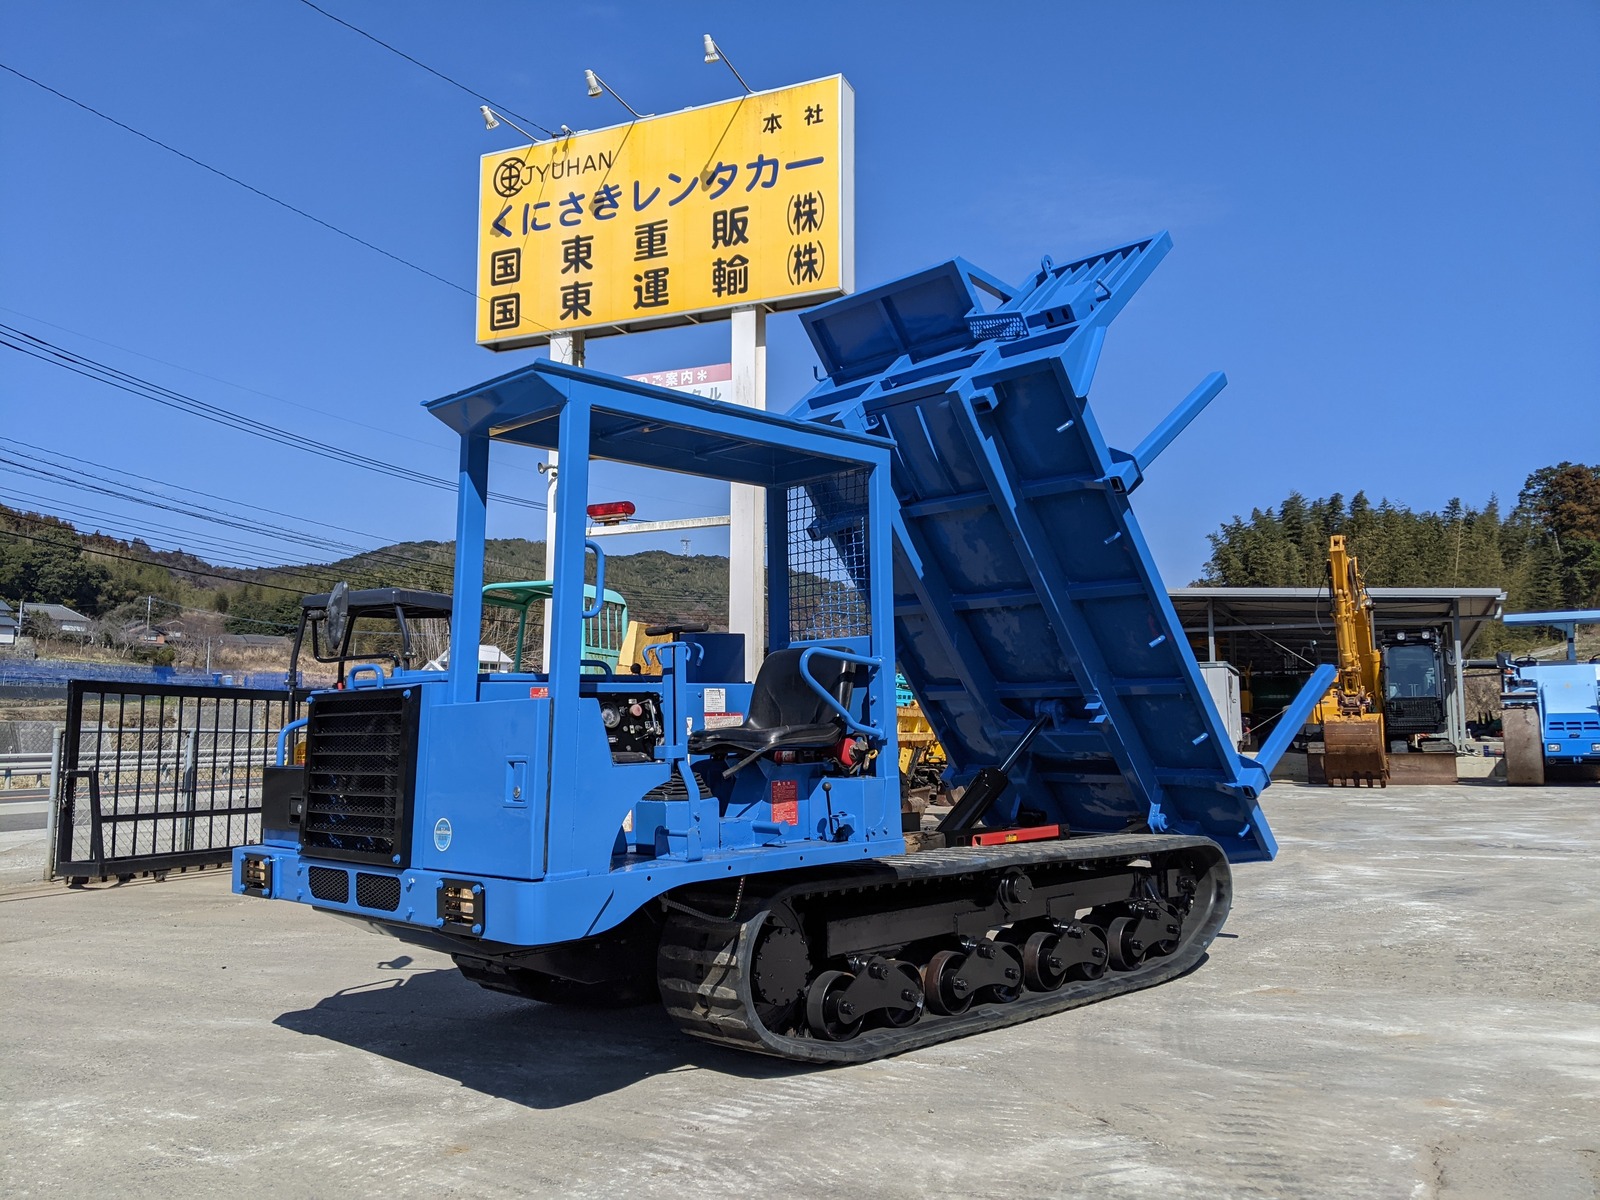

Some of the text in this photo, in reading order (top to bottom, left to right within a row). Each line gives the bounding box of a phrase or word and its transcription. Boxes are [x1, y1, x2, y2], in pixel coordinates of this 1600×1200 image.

[762, 104, 825, 134] 本社
[520, 150, 612, 186] JYUHAN
[491, 153, 826, 238] くにさきレンタカー
